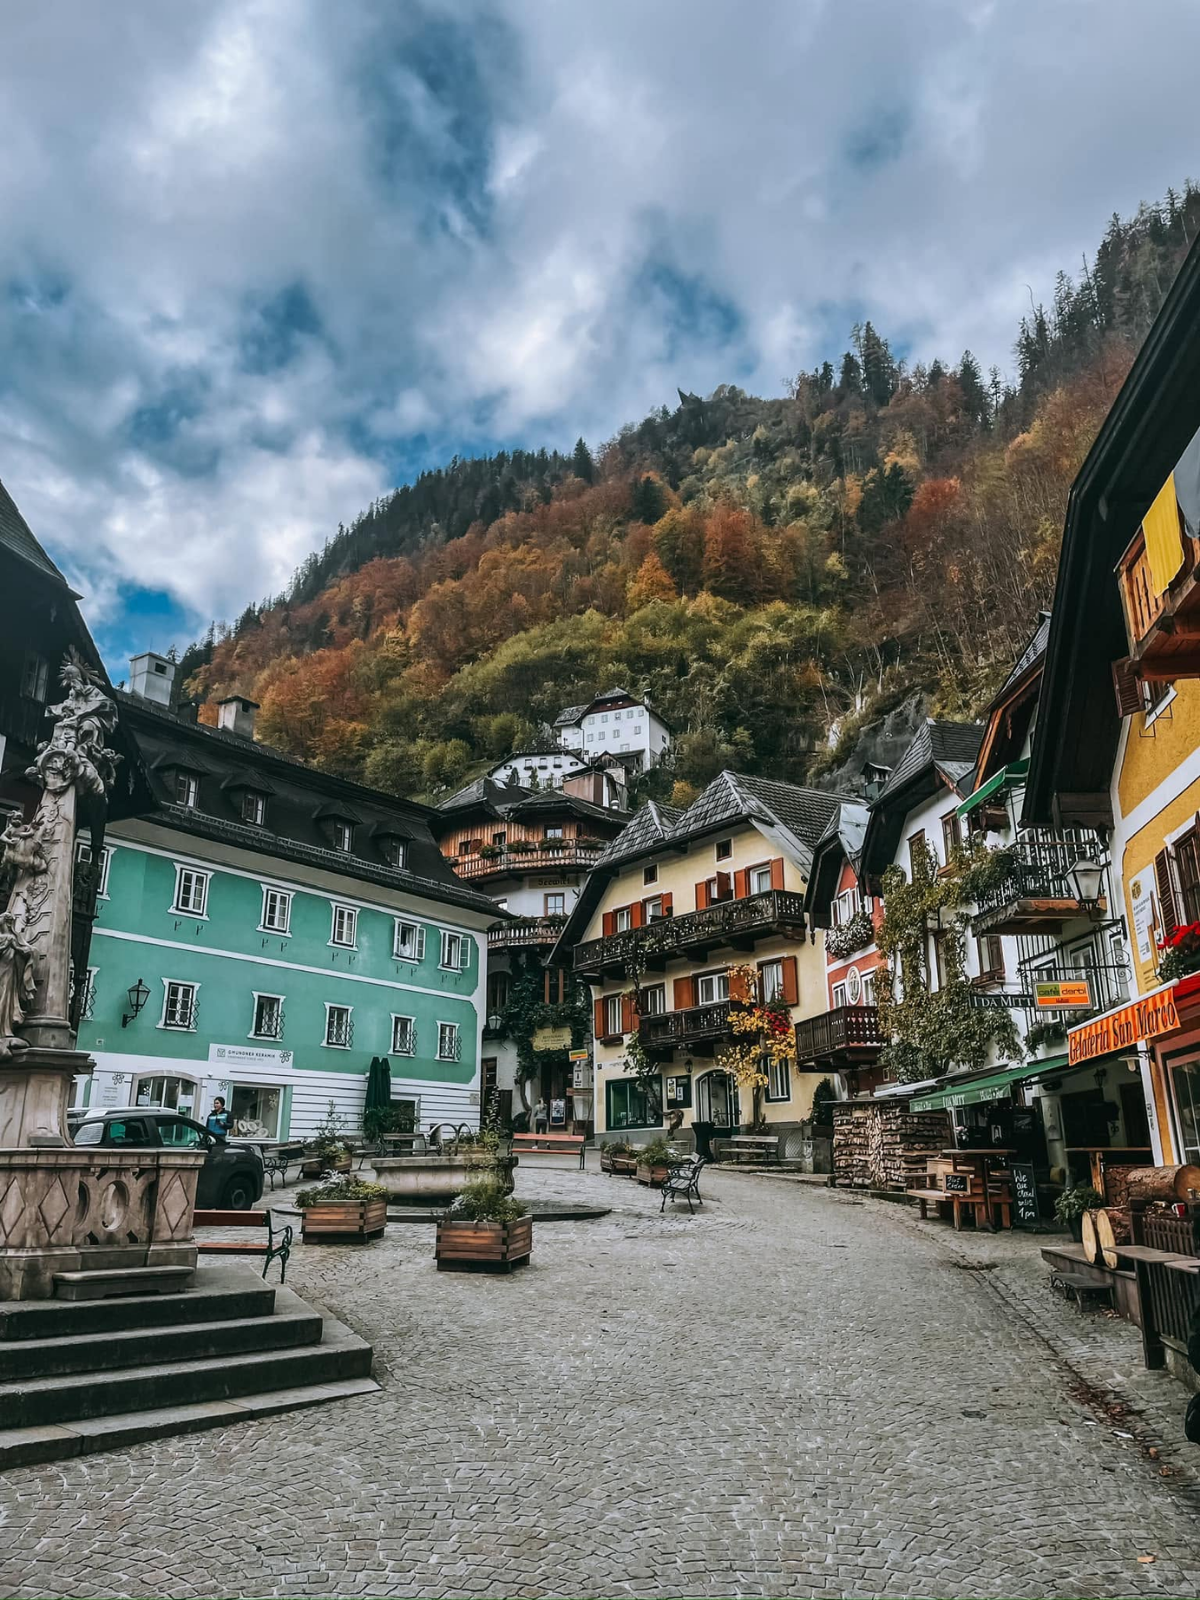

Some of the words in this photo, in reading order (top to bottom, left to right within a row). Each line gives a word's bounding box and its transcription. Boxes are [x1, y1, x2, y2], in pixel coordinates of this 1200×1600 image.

[981, 997, 998, 1007] DA
[1000, 995, 1033, 1007] MITT
[1069, 1026, 1110, 1062] Gelateria
[1112, 1018, 1133, 1047] San
[1136, 1002, 1176, 1038] Marco
[255, 1051, 276, 1059] KERAMIK
[1013, 1169, 1028, 1183] We
